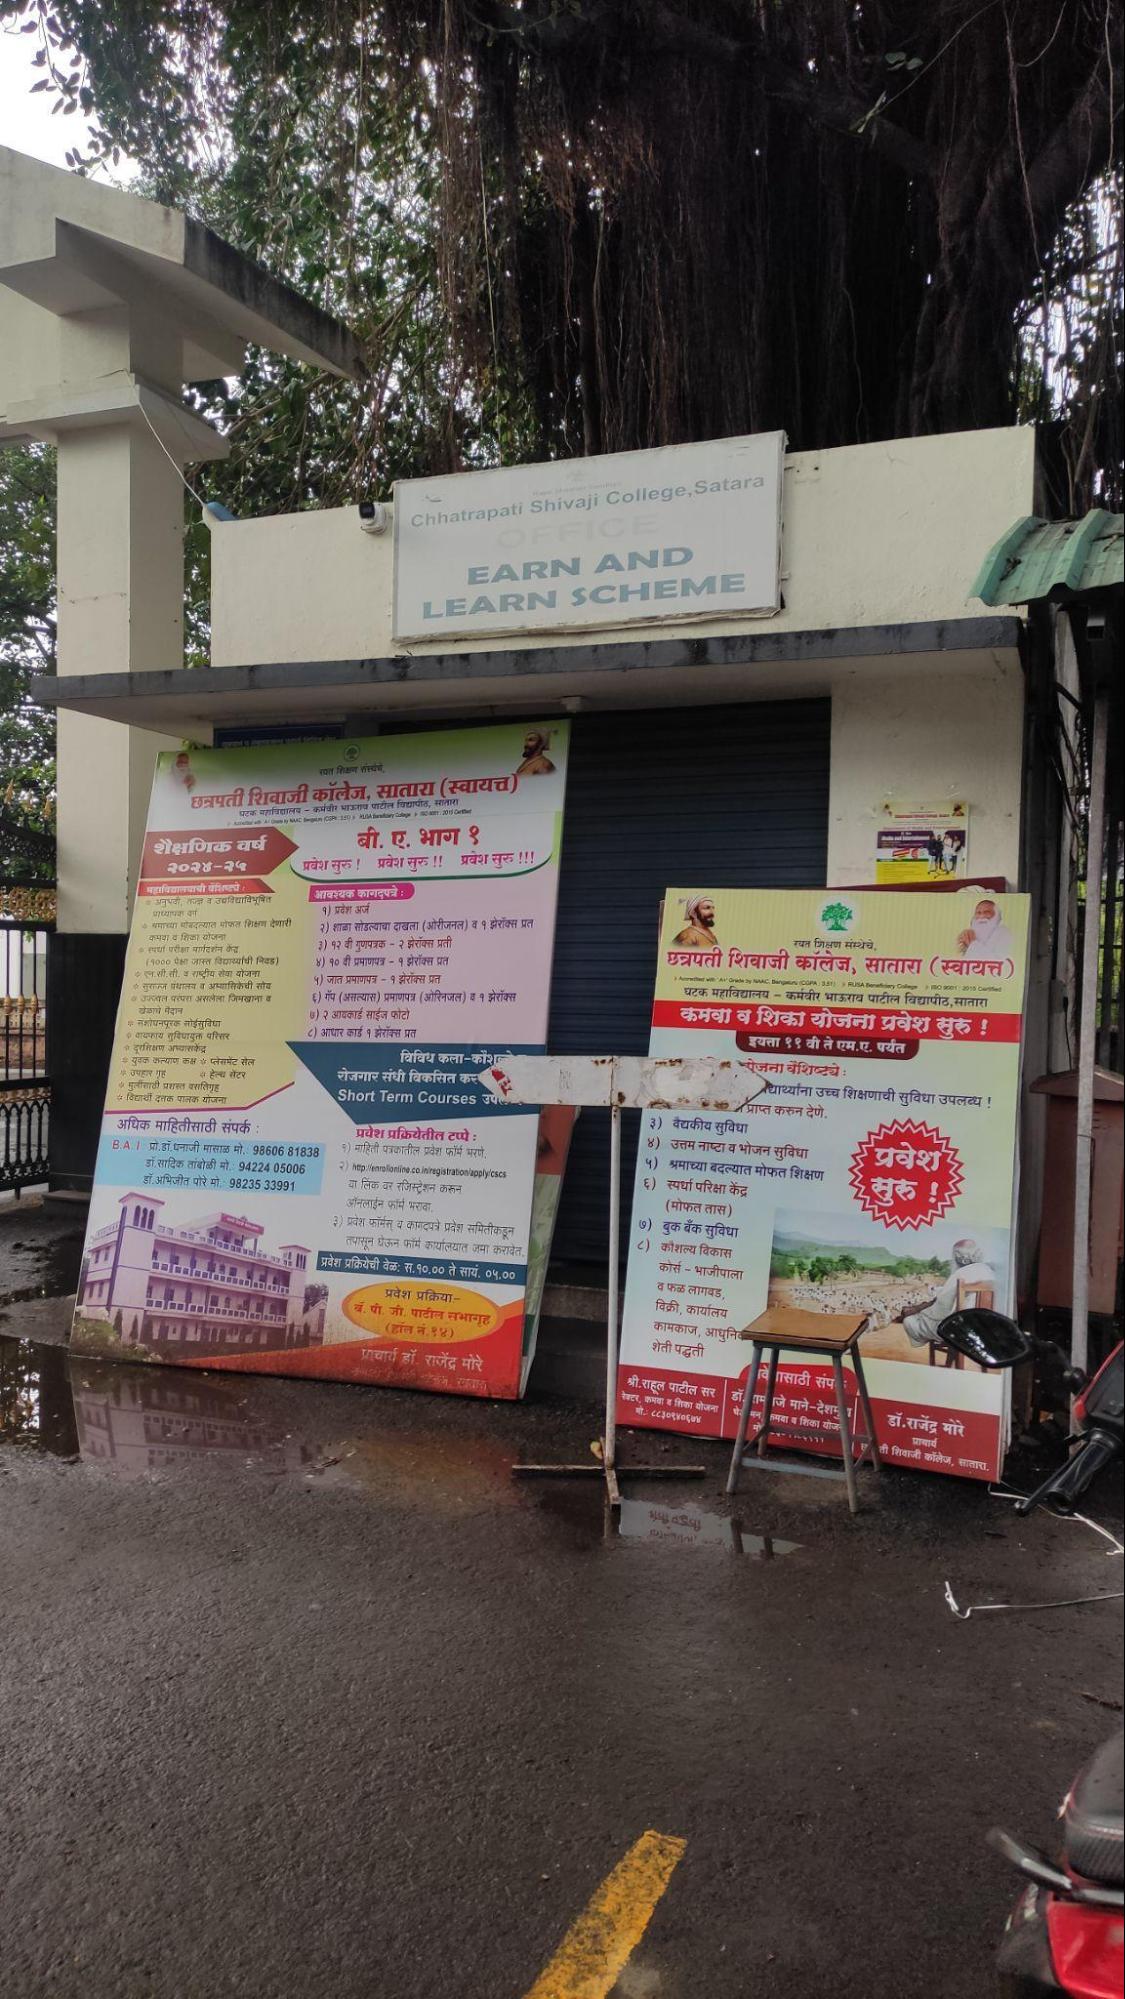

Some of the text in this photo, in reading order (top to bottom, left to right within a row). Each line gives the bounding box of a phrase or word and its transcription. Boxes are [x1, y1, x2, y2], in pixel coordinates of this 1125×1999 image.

[410, 501, 523, 528] Chhatrapati
[530, 493, 599, 515] Shivaji
[498, 514, 662, 549] OFFICE
[468, 547, 694, 585] EARN AND
[424, 573, 745, 620] LEARN SCHEME
[191, 788, 244, 809] छत्रपती
[248, 784, 308, 806] शिवाजी
[377, 782, 434, 800] सातारा
[237, 835, 268, 851] वर्ष
[357, 825, 480, 849] बी. ए. भाग १
[667, 946, 723, 968] छत्रपती
[729, 948, 789, 971] शिवाजी
[865, 956, 922, 975] सातारा
[680, 1007, 732, 1024] कमवा
[737, 1010, 751, 1024] व
[757, 1005, 806, 1026] शिका
[811, 1007, 876, 1029] योजना
[881, 1011, 930, 1033] प्रवेश
[338, 1089, 476, 1105] Short Term Courses
[899, 1089, 934, 1106] सुविधा
[117, 1116, 150, 1130] अधिक
[716, 1119, 748, 1135] सुविधा
[729, 1144, 735, 1153] व
[739, 1141, 770, 1156] भोजन
[774, 1145, 808, 1161] सुविधा
[874, 1142, 942, 1172] प्रवेश
[239, 1162, 305, 1174] 94224 05006
[790, 1165, 824, 1181] शिक्षण
[230, 1177, 295, 1191] 98235 33991
[870, 1176, 918, 1207] सुरु
[663, 1220, 680, 1235] बुक
[705, 1222, 738, 1239] सुविधा
[700, 1243, 732, 1258] विकास
[695, 1265, 743, 1280] भाजीपाला
[658, 1282, 663, 1291] व
[652, 1339, 672, 1353] शेती
[702, 1387, 715, 1398] सर
[943, 1419, 965, 1437] मोरे
